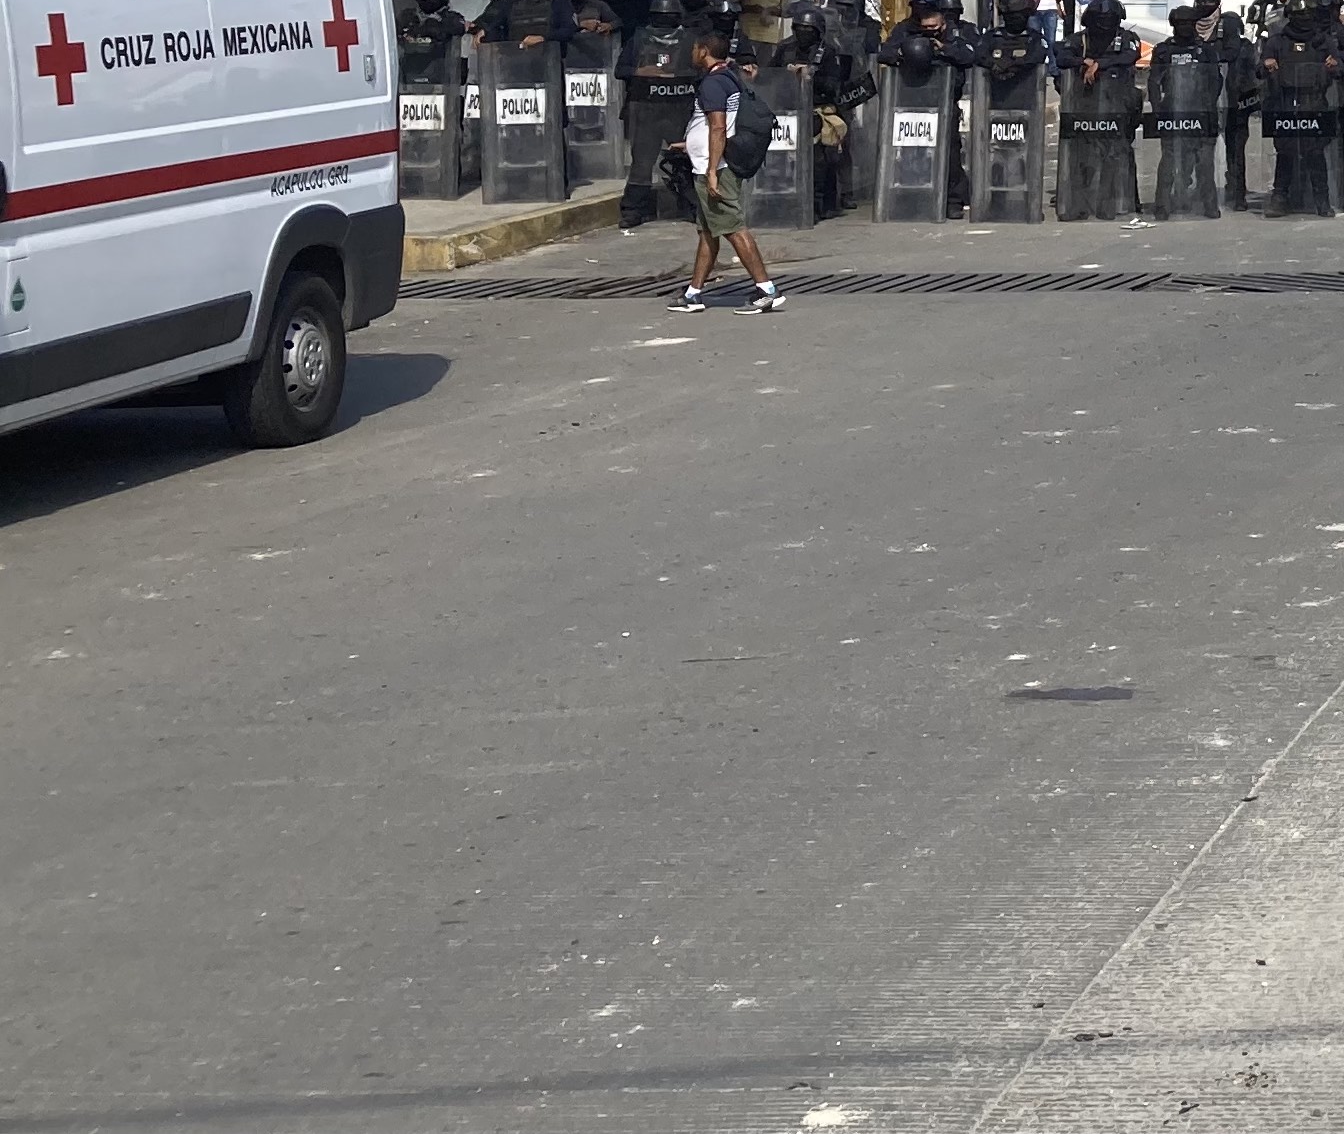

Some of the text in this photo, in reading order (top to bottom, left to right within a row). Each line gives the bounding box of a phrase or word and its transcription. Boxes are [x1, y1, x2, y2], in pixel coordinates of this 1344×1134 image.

[101, 21, 313, 69] CRUZ ROJA MEXICANA
[570, 82, 602, 98] POLICIA
[650, 84, 695, 96] POLICIA
[402, 104, 439, 121] POLICIA
[502, 98, 538, 115] POLICIA
[900, 122, 931, 138] POLICIA
[992, 124, 1024, 140] POLICIA
[1074, 120, 1118, 131] POLICIA
[1157, 119, 1202, 131] POLICIA
[1276, 119, 1319, 130] POLICIA
[270, 165, 351, 198] ACAPULCO, GRO.
